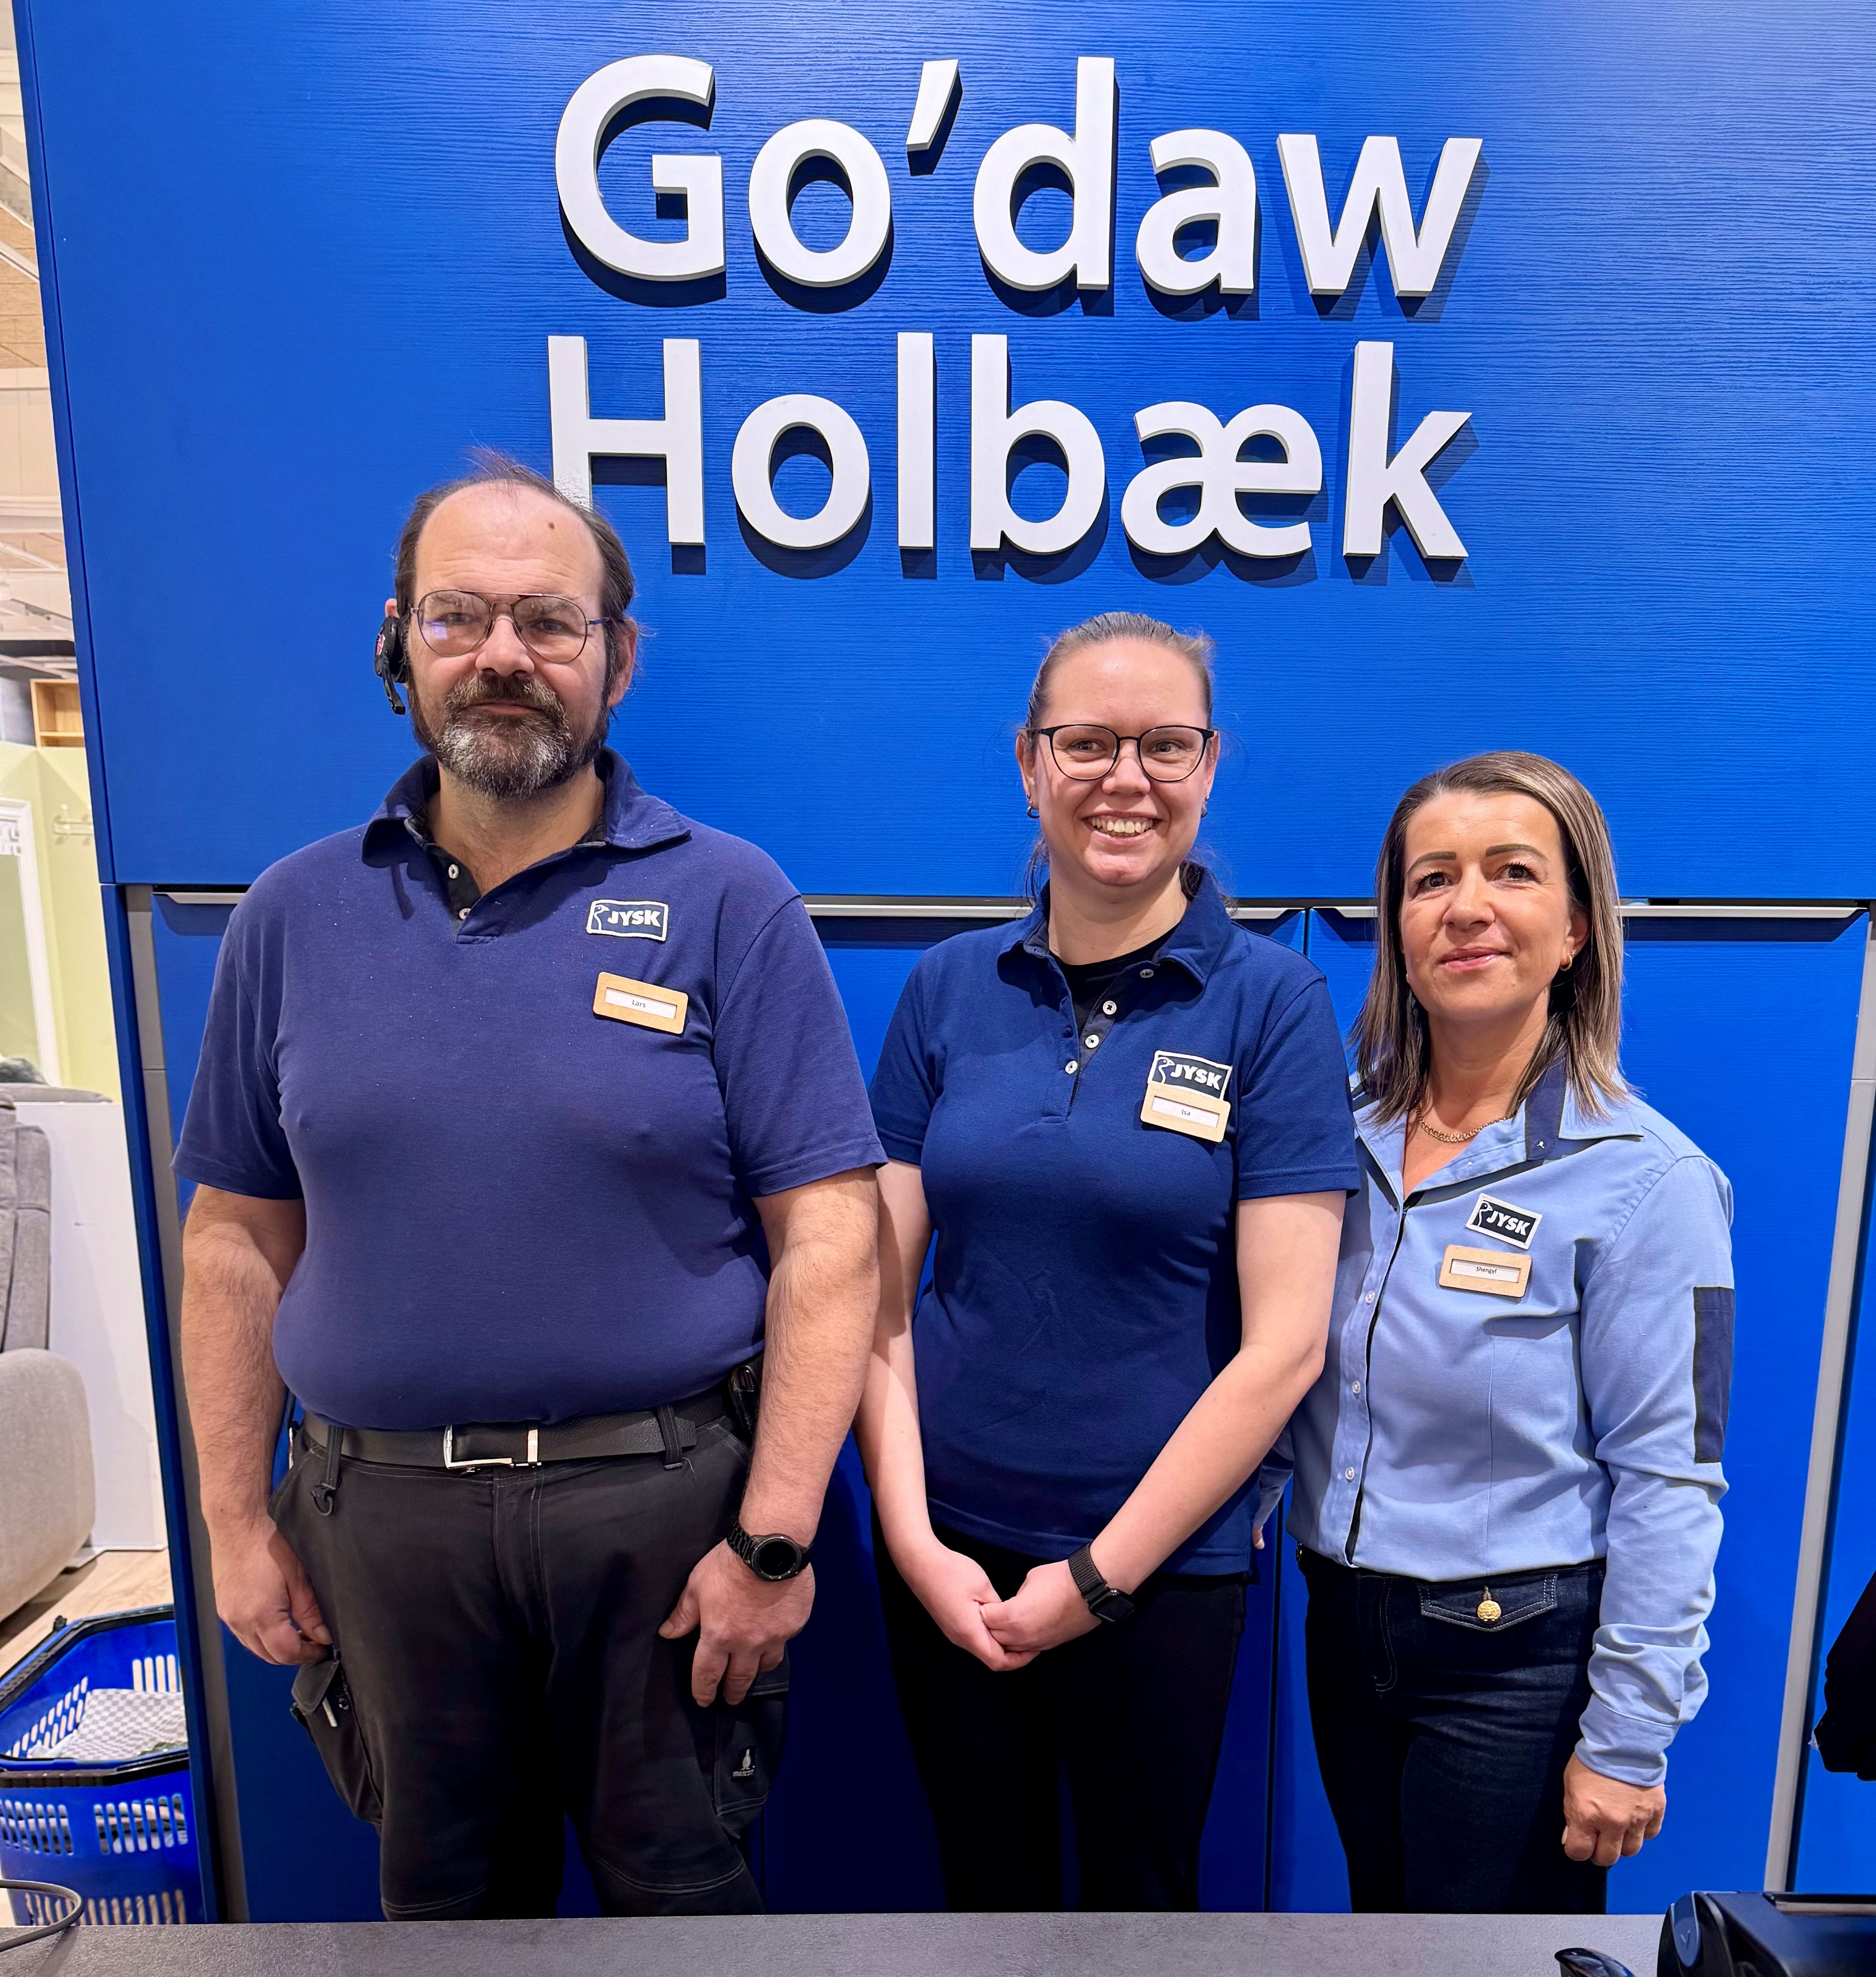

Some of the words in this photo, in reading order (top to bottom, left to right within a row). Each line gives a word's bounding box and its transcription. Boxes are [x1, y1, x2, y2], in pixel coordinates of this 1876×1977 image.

[547, 332, 1472, 559] Holbæk
[607, 910, 661, 927] JYSK
[632, 999, 646, 1008] Lars
[1170, 1064, 1222, 1090] JYSK
[1486, 1210, 1530, 1235] JYSK
